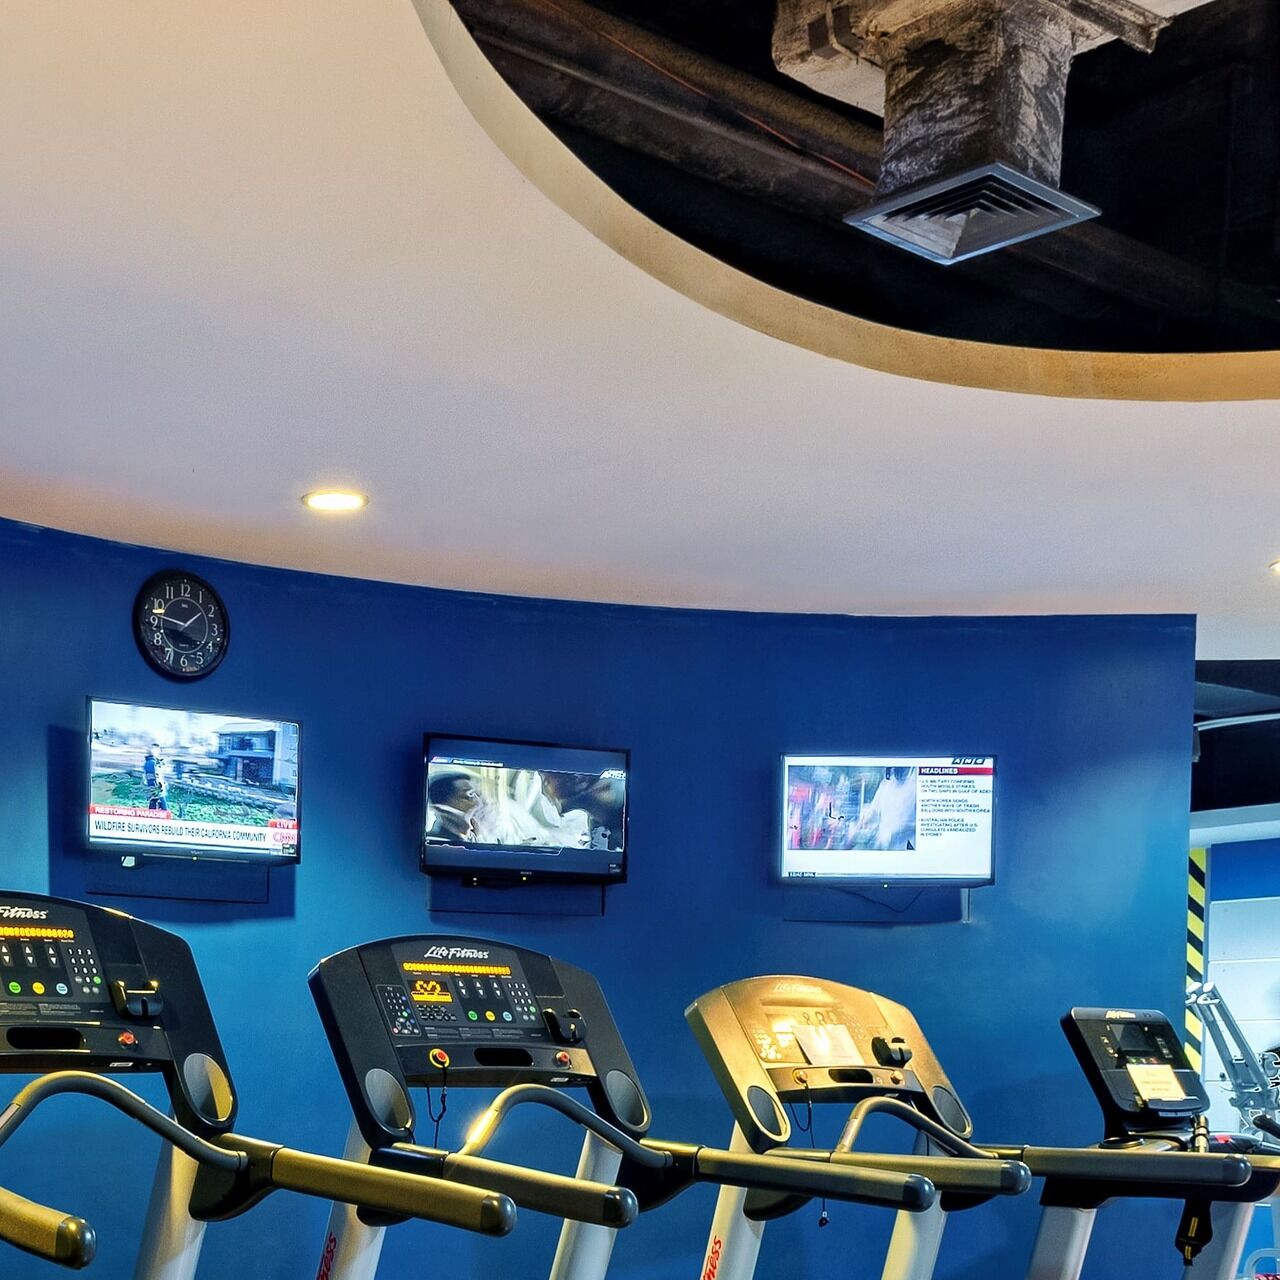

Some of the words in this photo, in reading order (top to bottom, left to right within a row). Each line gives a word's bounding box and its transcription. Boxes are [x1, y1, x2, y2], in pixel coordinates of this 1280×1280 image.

[165, 586, 174, 600] 11
[180, 583, 191, 598] 12
[207, 604, 215, 618] 2
[150, 615, 158, 631] 9
[211, 623, 218, 637] 3
[153, 632, 162, 646] 8
[180, 654, 188, 667] 6
[195, 652, 204, 665] 5
[921, 767, 959, 775] HEADLINES
[95, 820, 126, 832] WILDFIRE
[127, 823, 160, 834] SURVIVORS
[161, 825, 183, 836] REBUILD
[185, 827, 200, 838] THEIR
[201, 828, 231, 839] CALIFORNIA
[232, 830, 266, 842] COMMUNITY
[276, 821, 293, 829] LIVE
[424, 945, 449, 959] Life
[448, 947, 489, 959] Fitness
